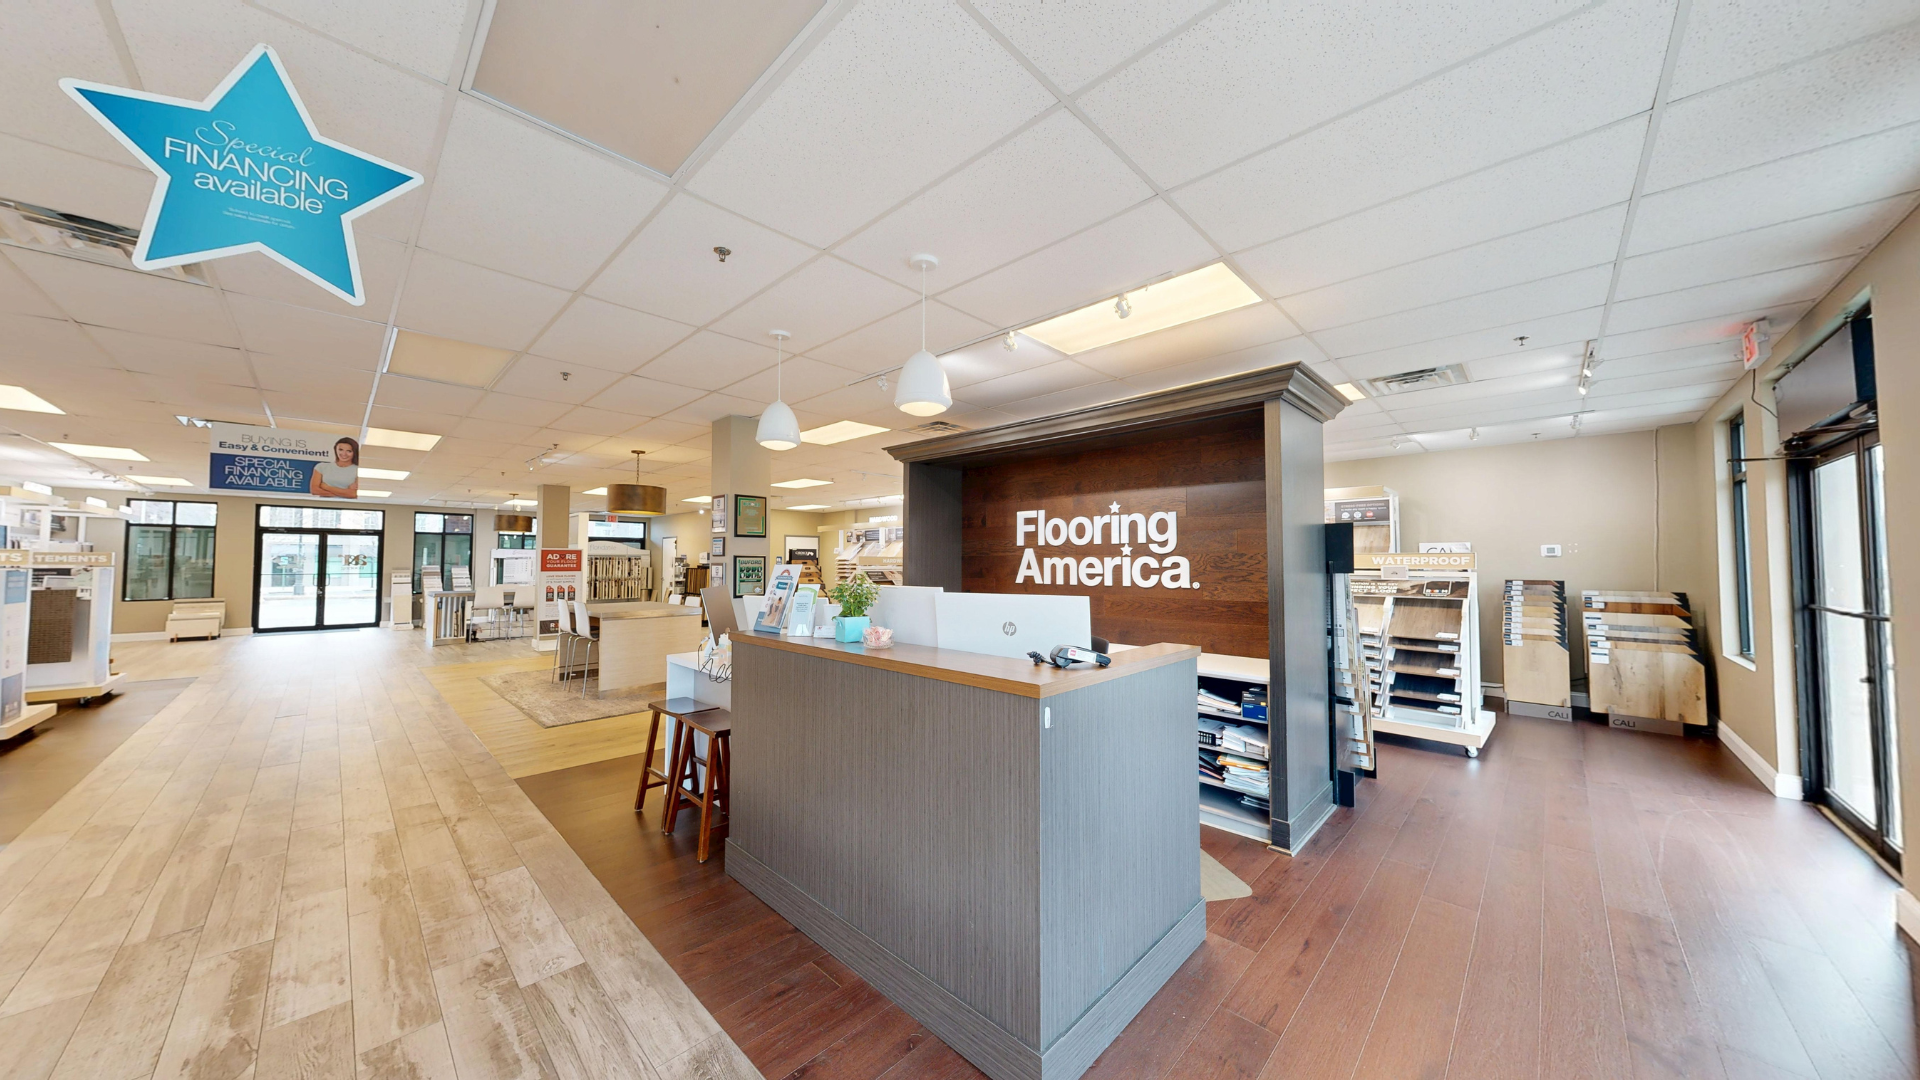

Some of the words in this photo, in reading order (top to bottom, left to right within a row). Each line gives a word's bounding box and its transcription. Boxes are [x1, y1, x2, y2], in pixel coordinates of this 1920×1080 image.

[195, 120, 315, 167] Special
[165, 137, 348, 201] FINANCING
[241, 434, 291, 446] BUYING
[296, 439, 306, 448] IS
[219, 441, 249, 451] Easy
[262, 445, 329, 457] Convenient!
[235, 457, 295, 469] SPECIAL
[225, 466, 303, 479] FINANCING
[225, 476, 302, 488] AVAILABLE
[1016, 501, 1178, 554] Flooring
[32, 555, 107, 563] TEMENTS
[1372, 556, 1470, 565] WATERPROOF
[1002, 621, 1017, 636] hp
[1548, 710, 1569, 719] CALI
[1613, 719, 1636, 728] CALI
